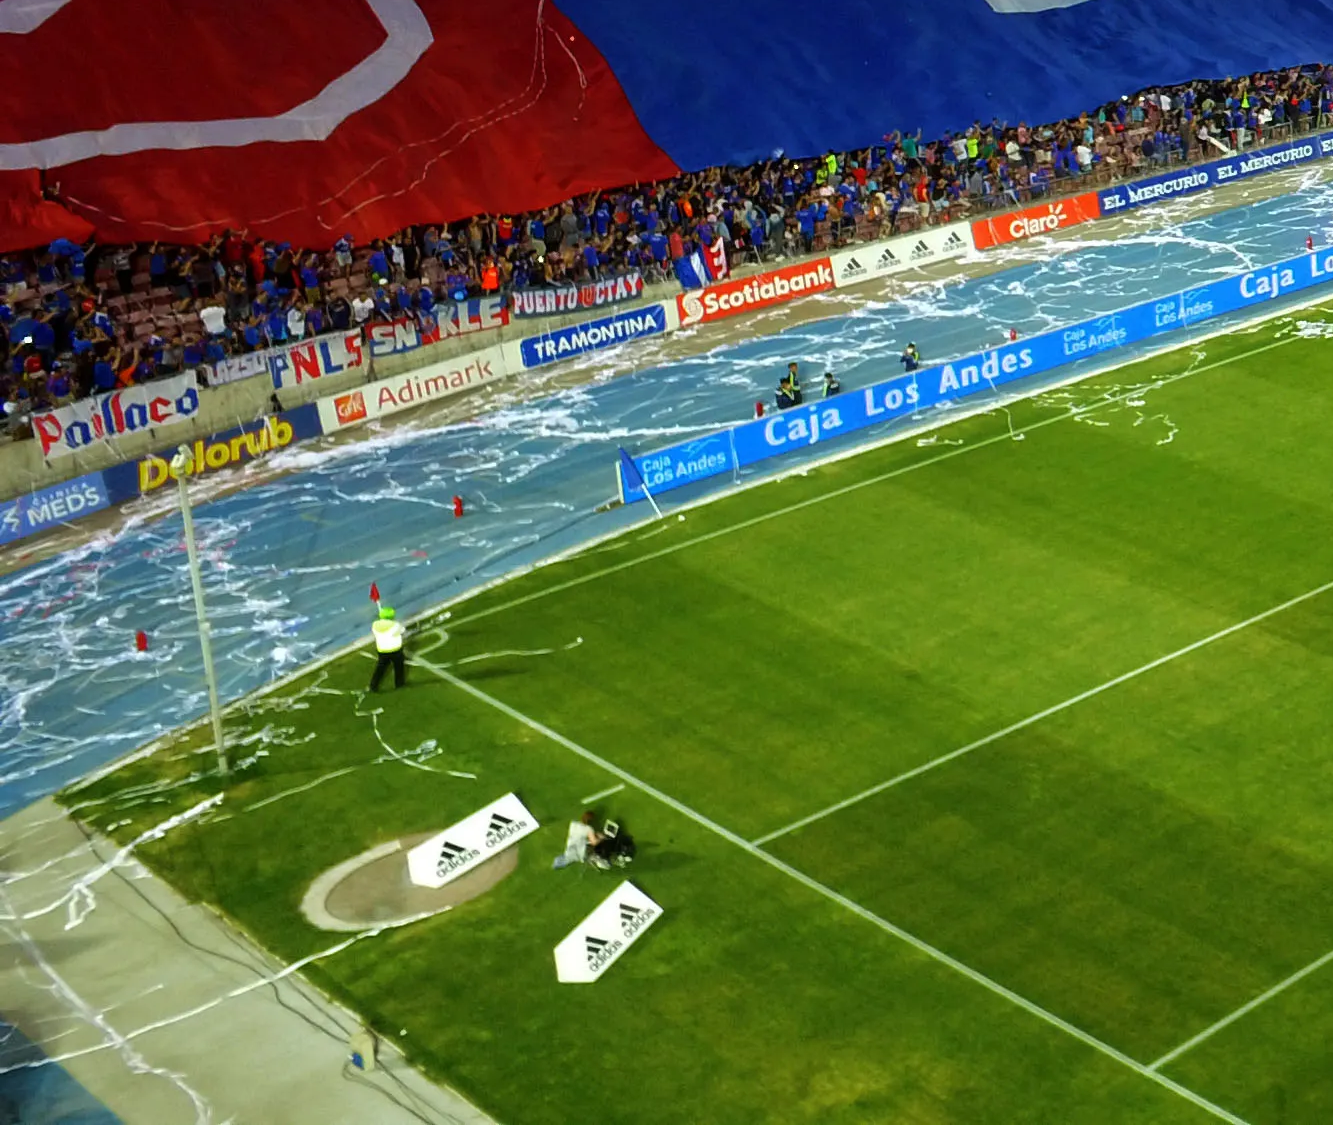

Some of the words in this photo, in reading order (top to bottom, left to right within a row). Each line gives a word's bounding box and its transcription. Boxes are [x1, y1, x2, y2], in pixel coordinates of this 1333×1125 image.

[1216, 165, 1237, 180] EL
[1241, 145, 1313, 174] MERCURIO
[1104, 194, 1125, 210] EL
[1129, 171, 1208, 202] MERCURIO
[1009, 213, 1059, 238] Claro
[512, 287, 577, 315] PUERTO
[704, 265, 833, 316] Scotiabank
[1240, 265, 1295, 299] Caja
[1155, 312, 1177, 327] Los
[1178, 300, 1213, 320] Andes
[533, 313, 658, 358] TRAMONTINA
[1064, 341, 1088, 356] Los
[1088, 327, 1127, 350] Andes
[378, 358, 493, 410] Adimark
[764, 405, 843, 446] Caja
[864, 383, 919, 416] Los
[939, 347, 1033, 394] Andes
[33, 387, 199, 457] Paillaco
[643, 470, 673, 487] Los
[675, 452, 726, 477] Andes
[27, 487, 100, 526] MEDS
[436, 847, 480, 878] adidas
[485, 820, 527, 849] adidas
[589, 939, 623, 973] adidas
[623, 907, 655, 939] adidas
